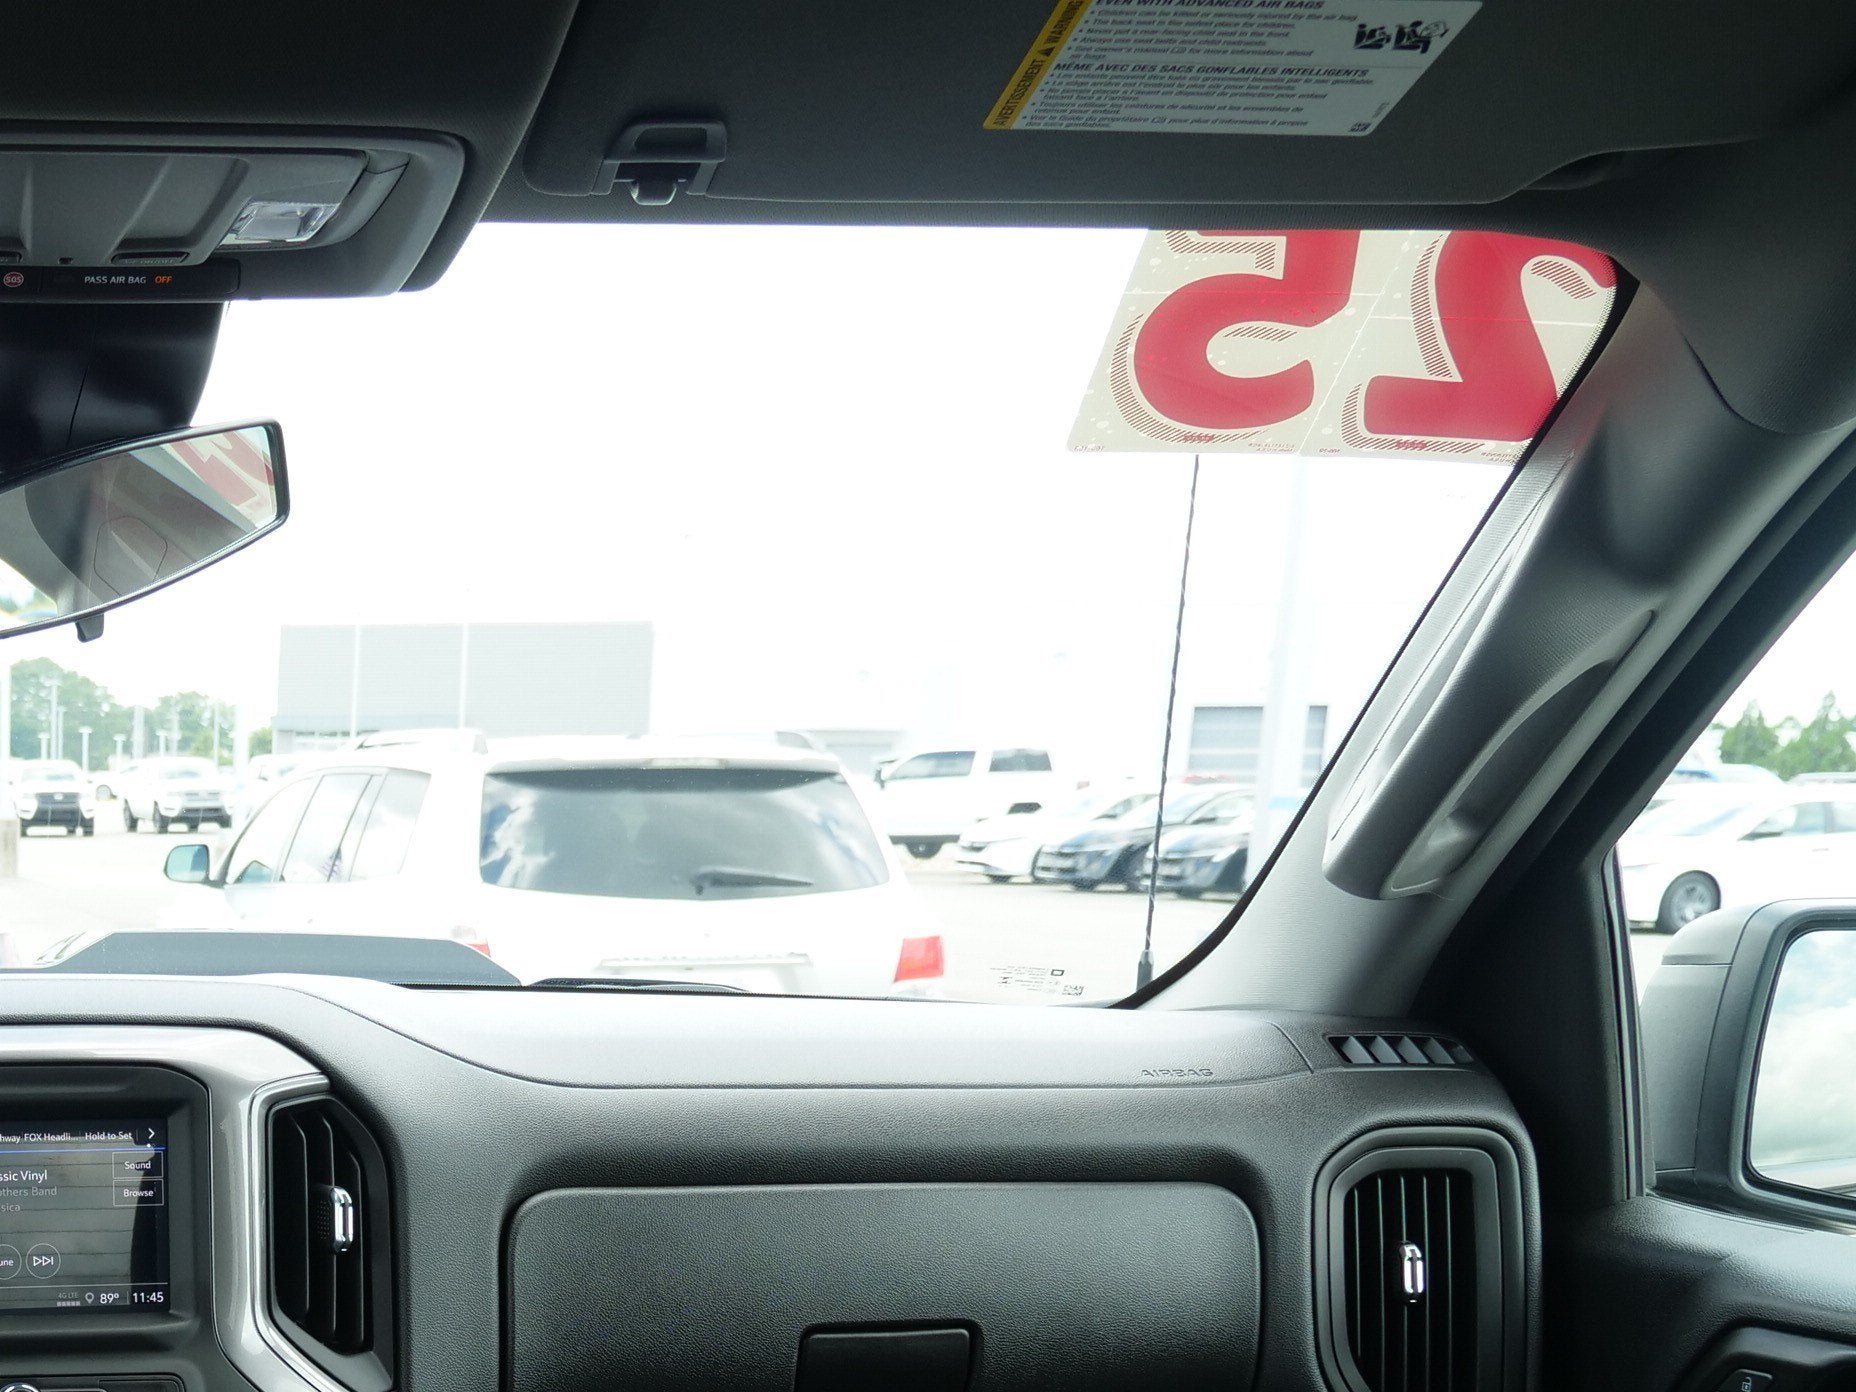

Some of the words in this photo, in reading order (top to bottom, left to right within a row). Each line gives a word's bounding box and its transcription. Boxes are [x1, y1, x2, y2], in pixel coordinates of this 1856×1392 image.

[1256, 0, 1282, 8] AIR
[1284, 0, 1325, 9] BAGS
[1131, 64, 1158, 72] DES
[1196, 66, 1278, 74] GONFLABLES
[1280, 68, 1370, 77] INTELLIGENTS
[5, 276, 22, 284] SOS
[84, 276, 108, 284] PASS
[110, 276, 125, 284] AIR
[128, 276, 146, 284] BAG
[154, 275, 172, 284] OFF
[1142, 1068, 1214, 1078] AIRBAG
[24, 1132, 42, 1141] FOX
[85, 1132, 106, 1140] Hold
[108, 1132, 116, 1140] to
[118, 1132, 132, 1140] Set
[124, 1161, 152, 1170] Sound
[20, 1170, 48, 1183] Vinyl
[31, 1186, 58, 1196] Band
[124, 1189, 154, 1197] Browse
[132, 1292, 165, 1303] 11:45
